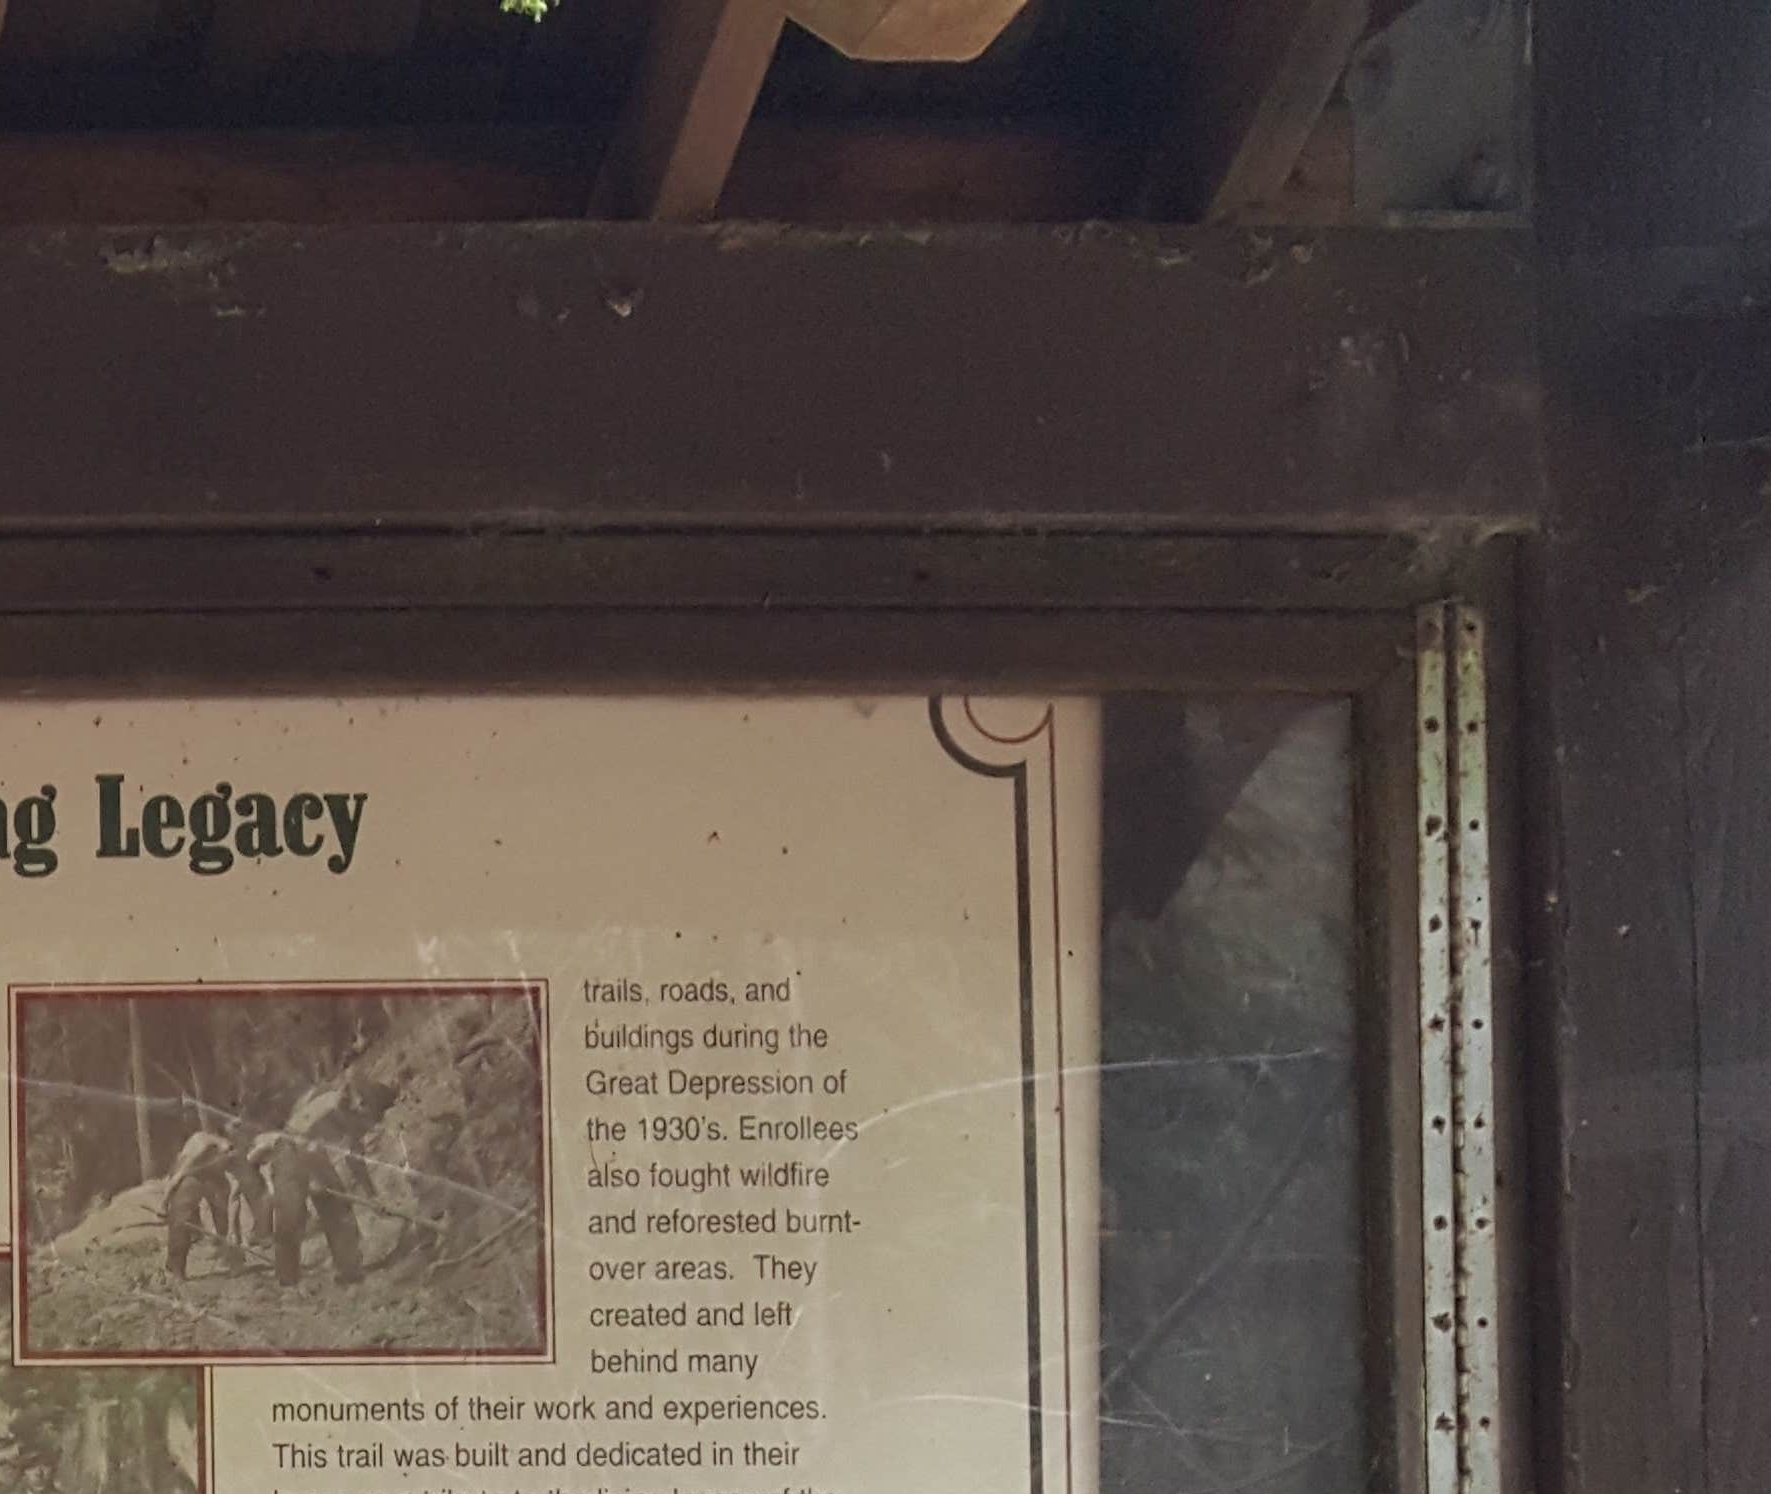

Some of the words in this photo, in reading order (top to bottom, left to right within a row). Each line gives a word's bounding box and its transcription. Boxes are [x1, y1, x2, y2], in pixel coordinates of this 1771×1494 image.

[94, 773, 369, 875] Legacy
[271, 1442, 328, 1469] This
[336, 1441, 383, 1468] trail
[392, 1447, 447, 1468] was
[454, 1440, 509, 1468] built
[517, 1441, 567, 1467] and
[575, 1440, 702, 1468] dedicated
[711, 1440, 733, 1466] in
[742, 1440, 800, 1466] their
